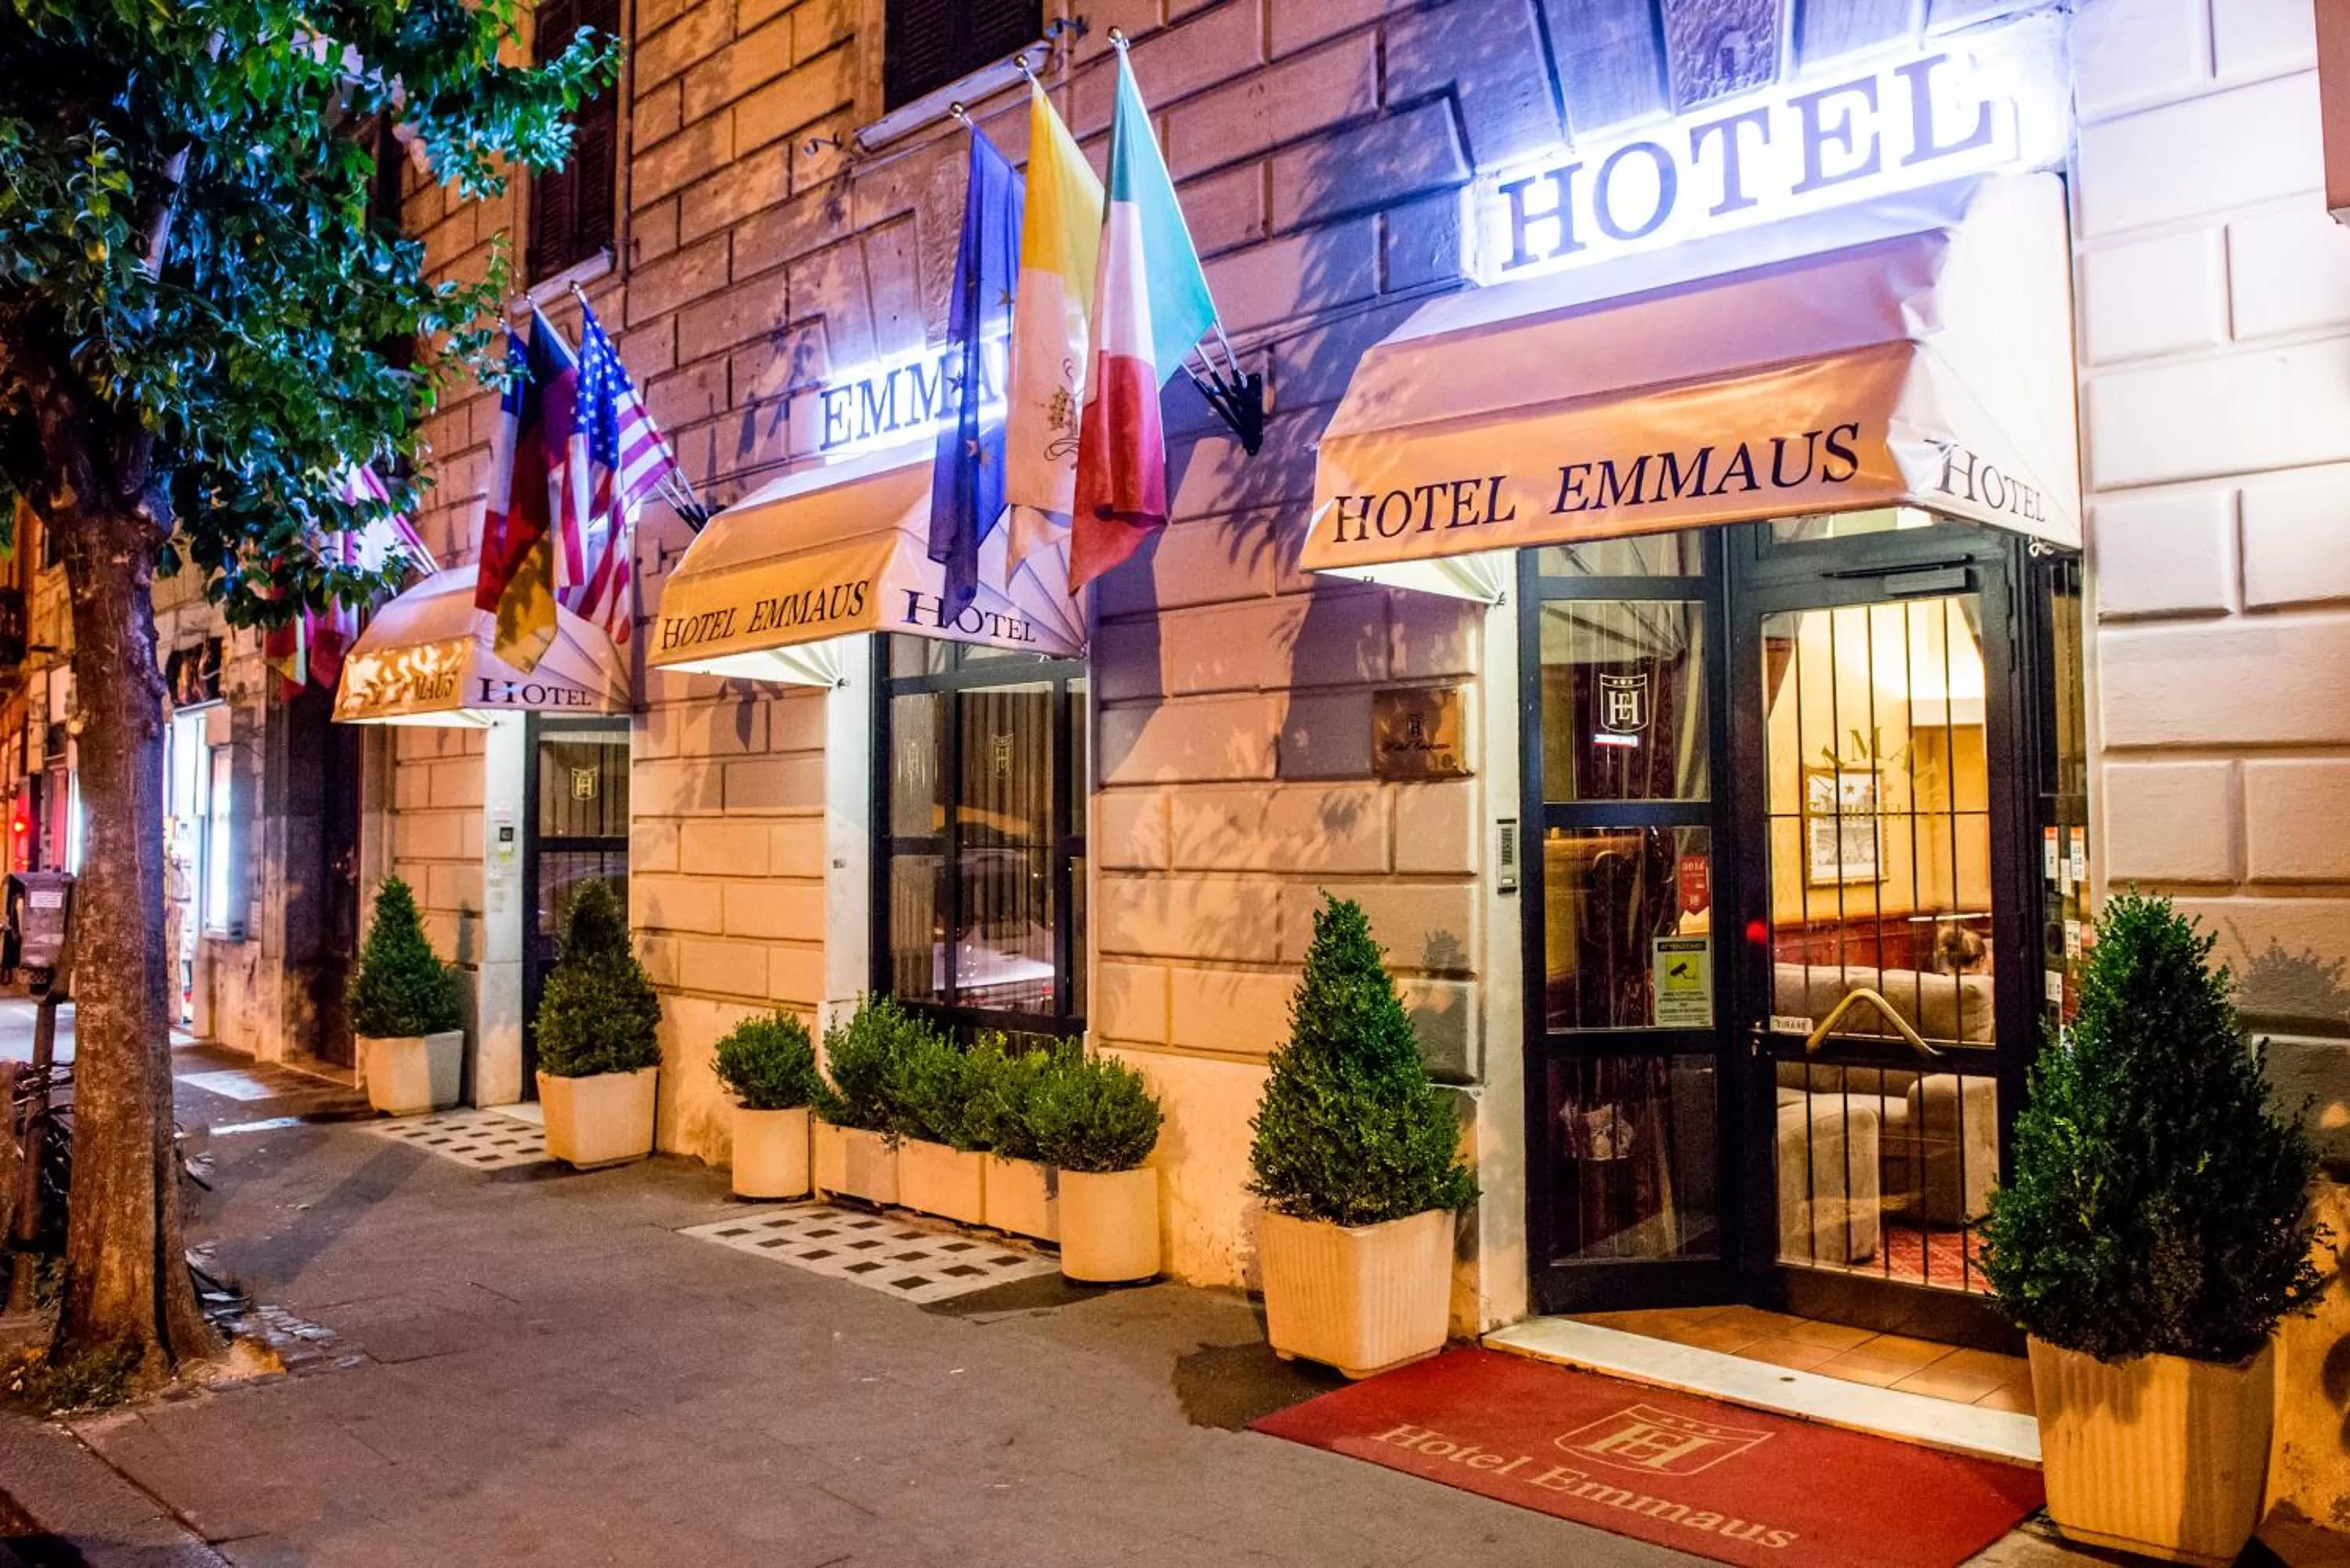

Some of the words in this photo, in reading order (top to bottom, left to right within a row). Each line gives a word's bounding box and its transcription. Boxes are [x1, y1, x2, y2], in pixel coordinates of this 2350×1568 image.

[1498, 52, 1994, 272] HOTEL
[1332, 476, 1517, 543] HOTEL
[1549, 422, 1860, 515] EMMAUS
[1924, 439, 2046, 522] HOTEL
[661, 607, 739, 651] HOTEL
[746, 580, 870, 634] EMMAUS
[900, 588, 1037, 643] HOTEL
[478, 677, 592, 706] HOTEL
[1370, 1422, 1535, 1476] Hotel
[1525, 1465, 1800, 1549] Emmaus
